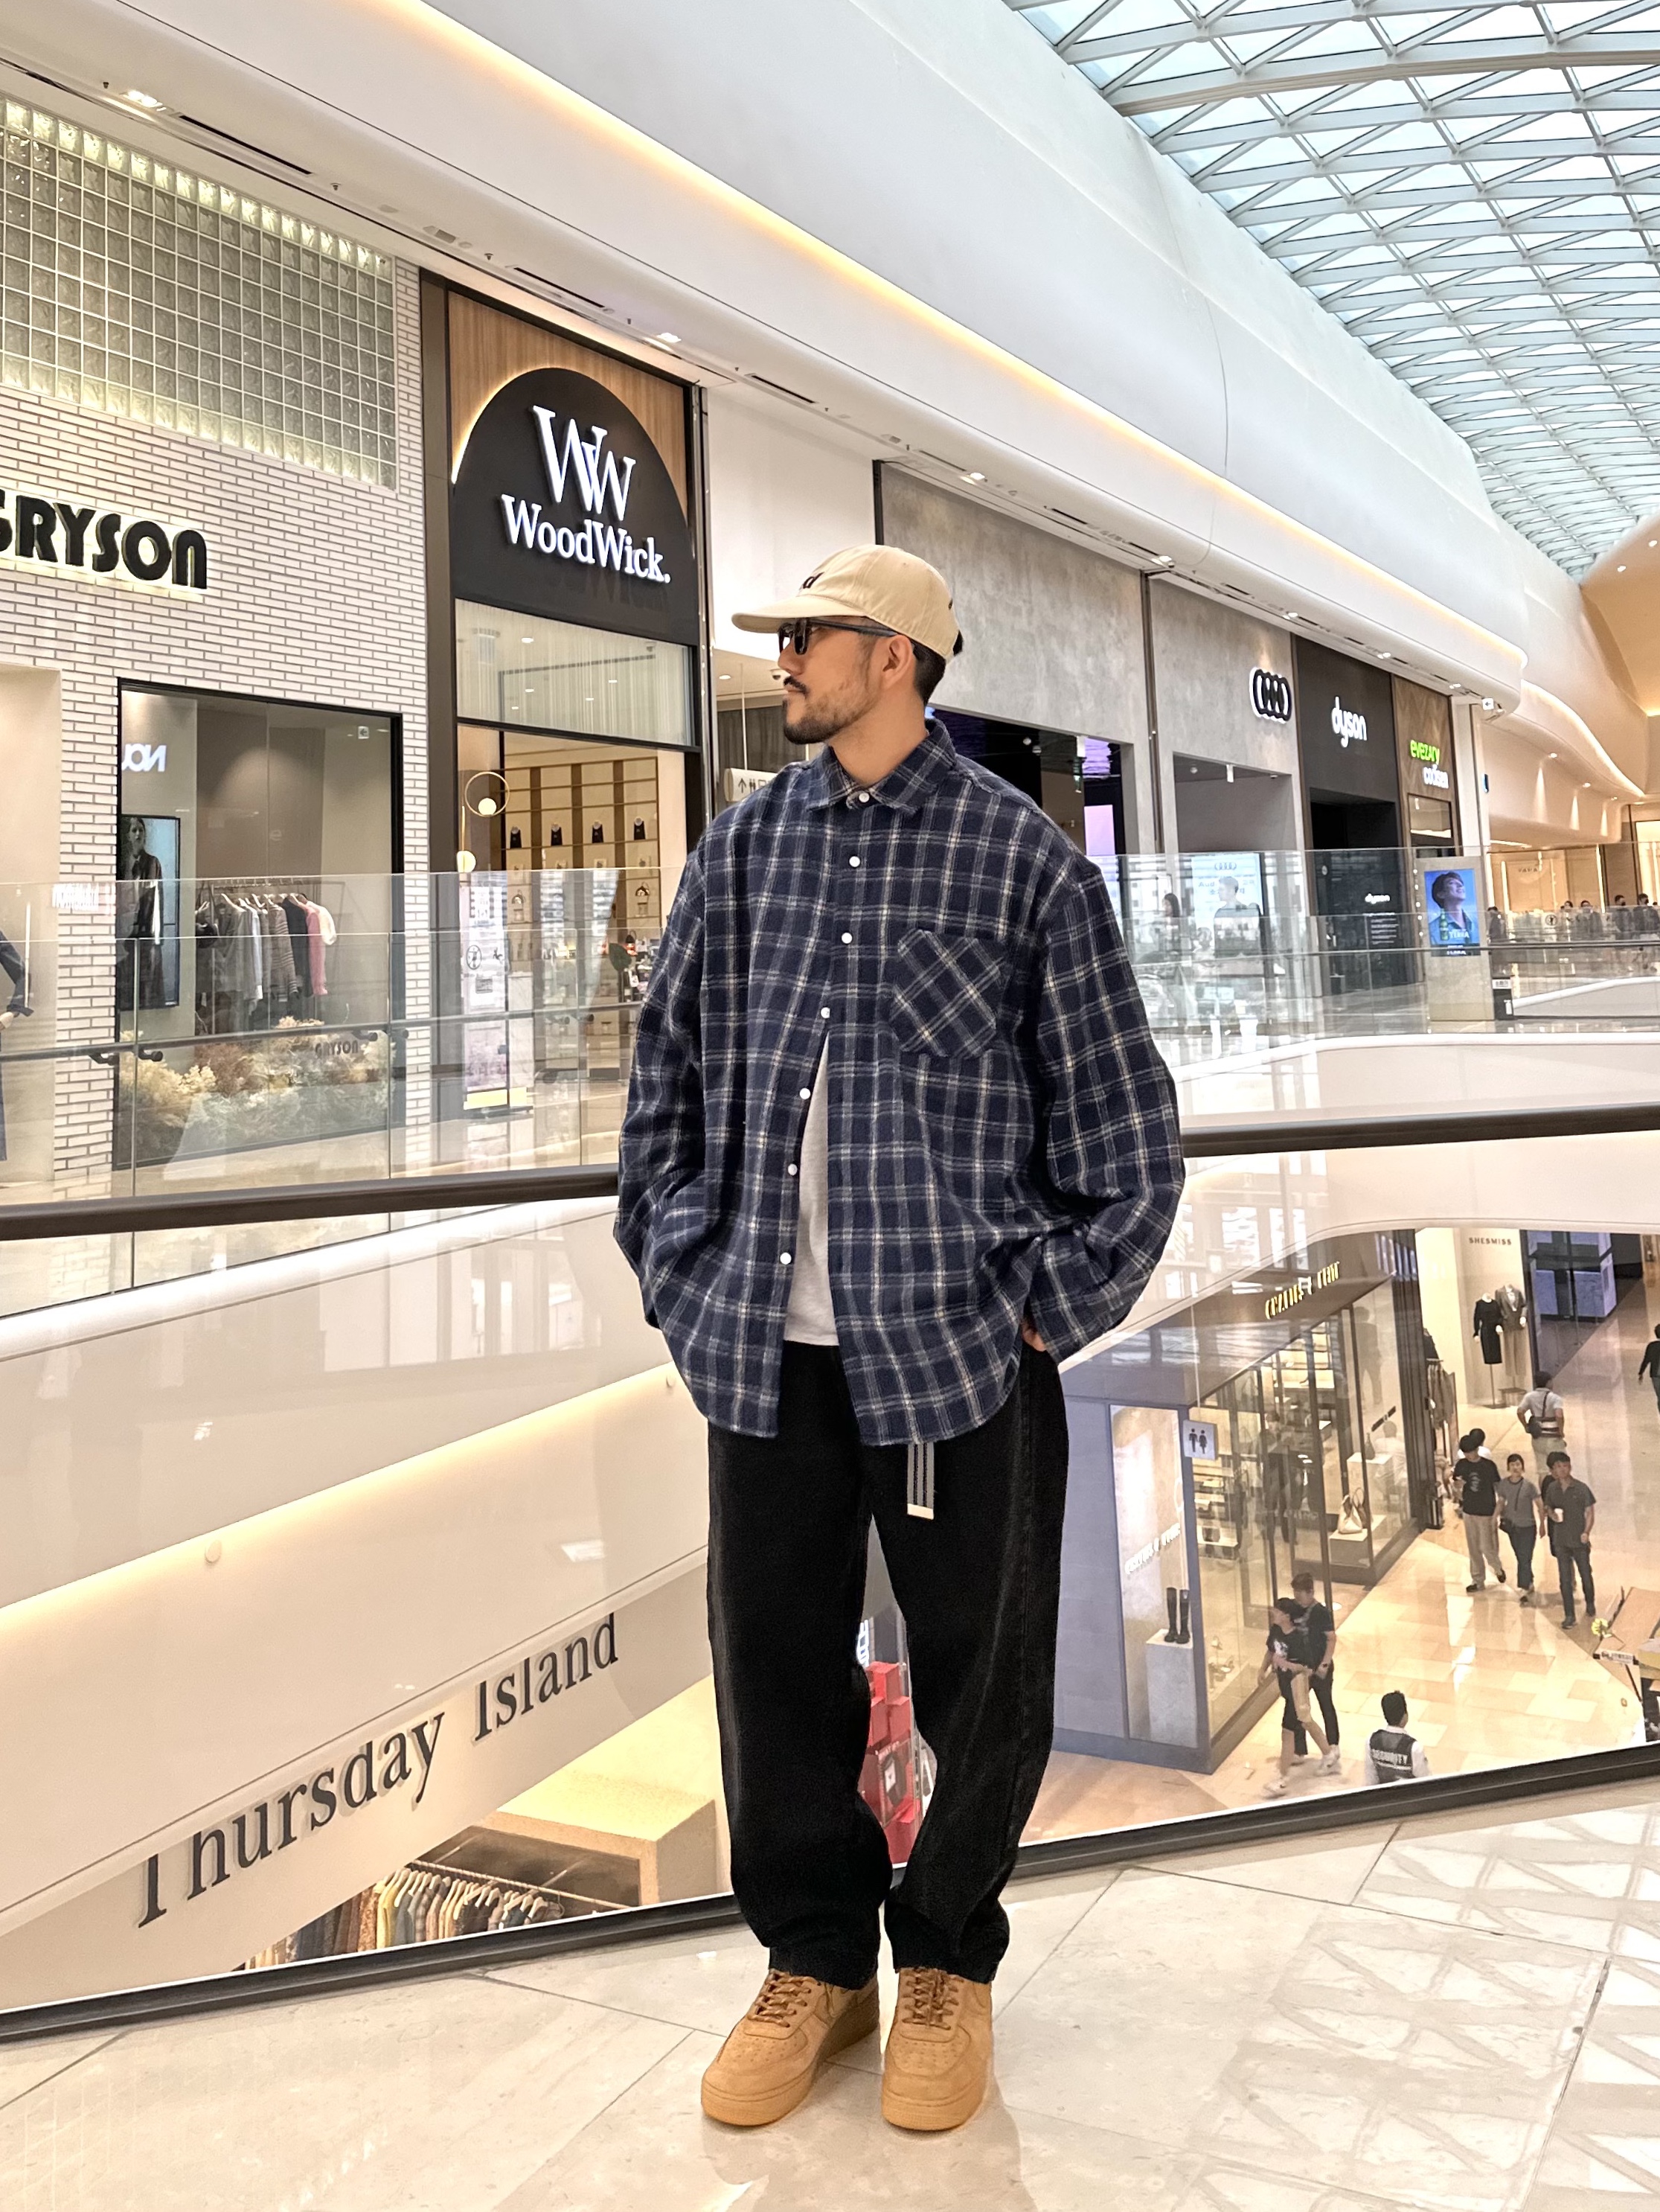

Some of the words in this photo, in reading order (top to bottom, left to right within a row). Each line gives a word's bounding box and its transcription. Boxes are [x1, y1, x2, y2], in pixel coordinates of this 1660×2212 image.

[0, 488, 208, 589] RYSON
[501, 494, 670, 584] WoodWick.
[1331, 696, 1368, 748] dyson
[1468, 1237, 1512, 1246] SHESMISS
[474, 1613, 619, 1742] Island
